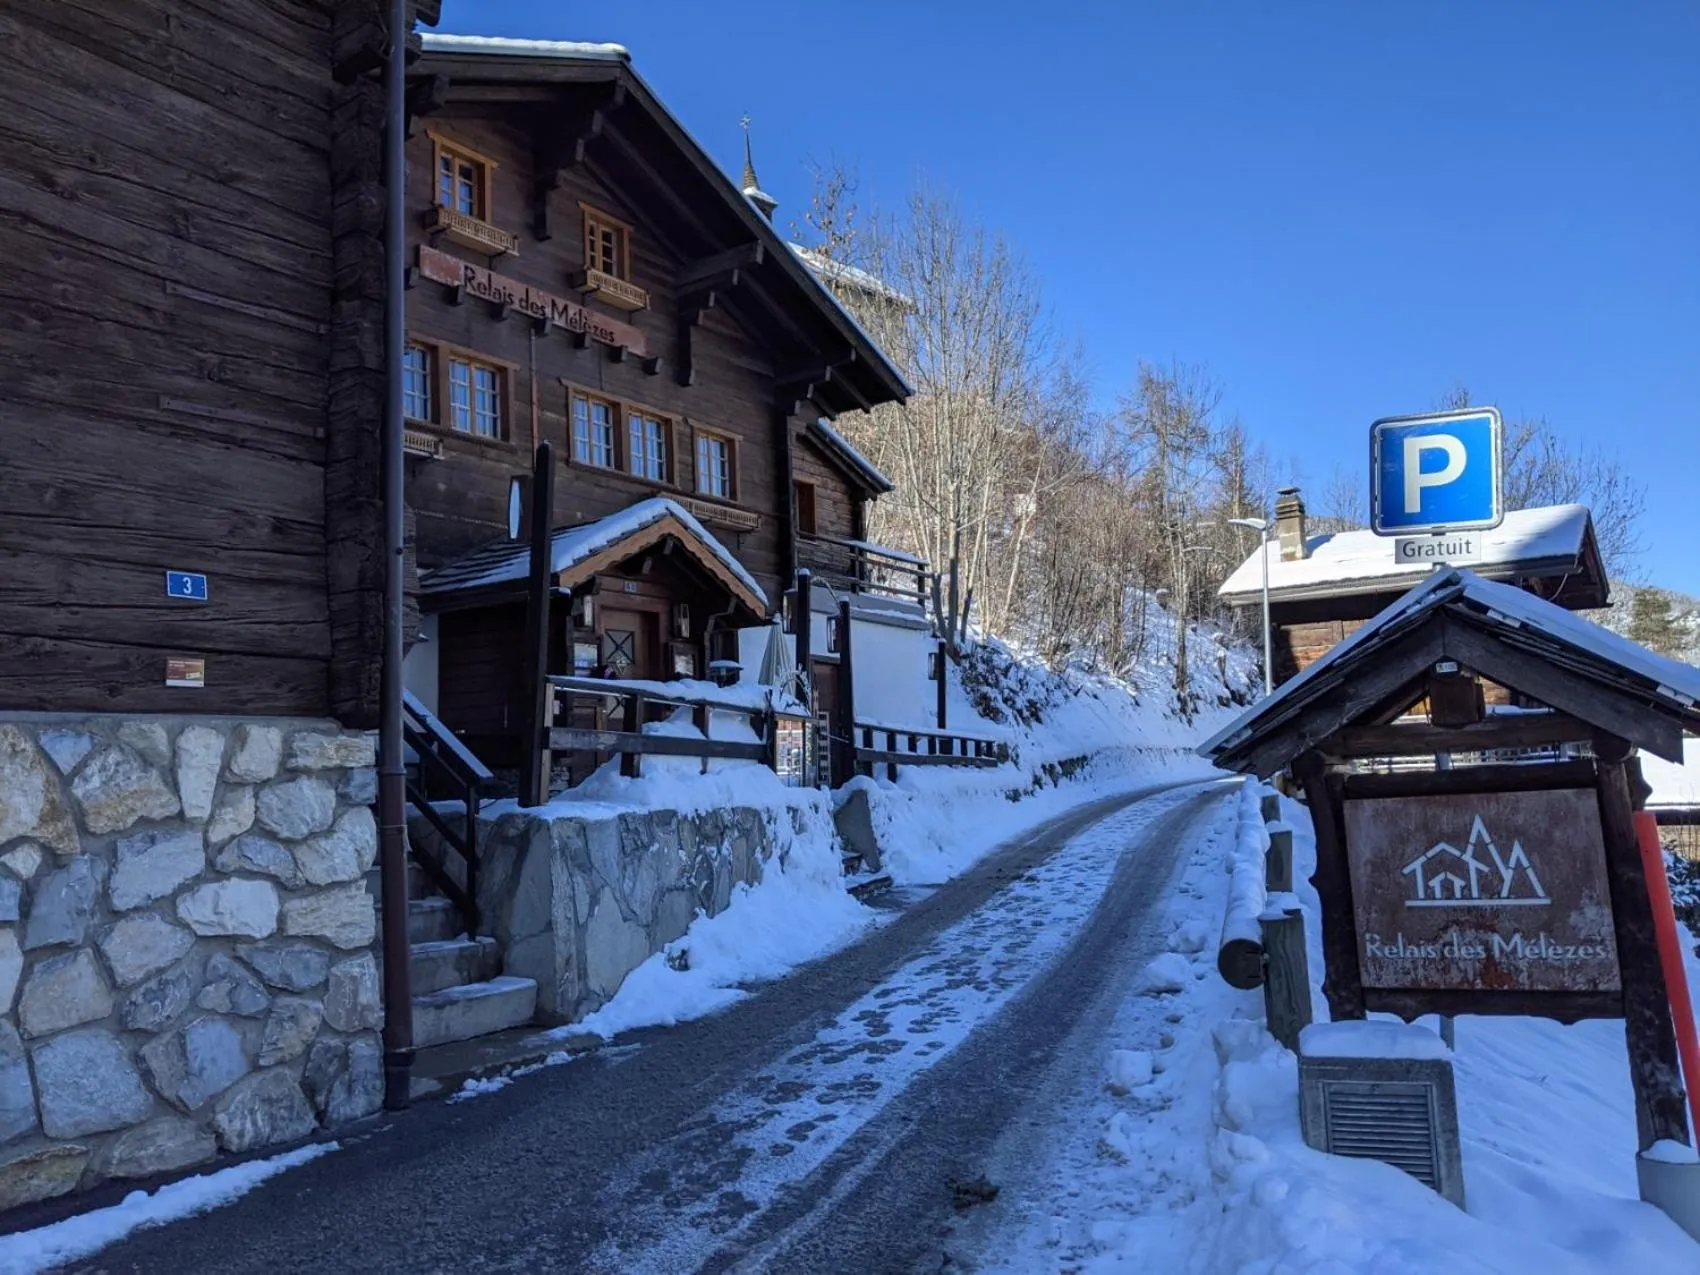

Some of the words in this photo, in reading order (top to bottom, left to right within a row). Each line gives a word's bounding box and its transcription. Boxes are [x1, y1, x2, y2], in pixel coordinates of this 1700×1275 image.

[464, 265, 514, 305] Relais
[519, 288, 547, 318] des
[1404, 434, 1467, 513] P
[1402, 538, 1472, 558] Gratuit
[183, 577, 192, 594] 3
[1365, 932, 1436, 959] Relais
[1444, 933, 1486, 960] des
[1494, 931, 1606, 961] Mélèzes
